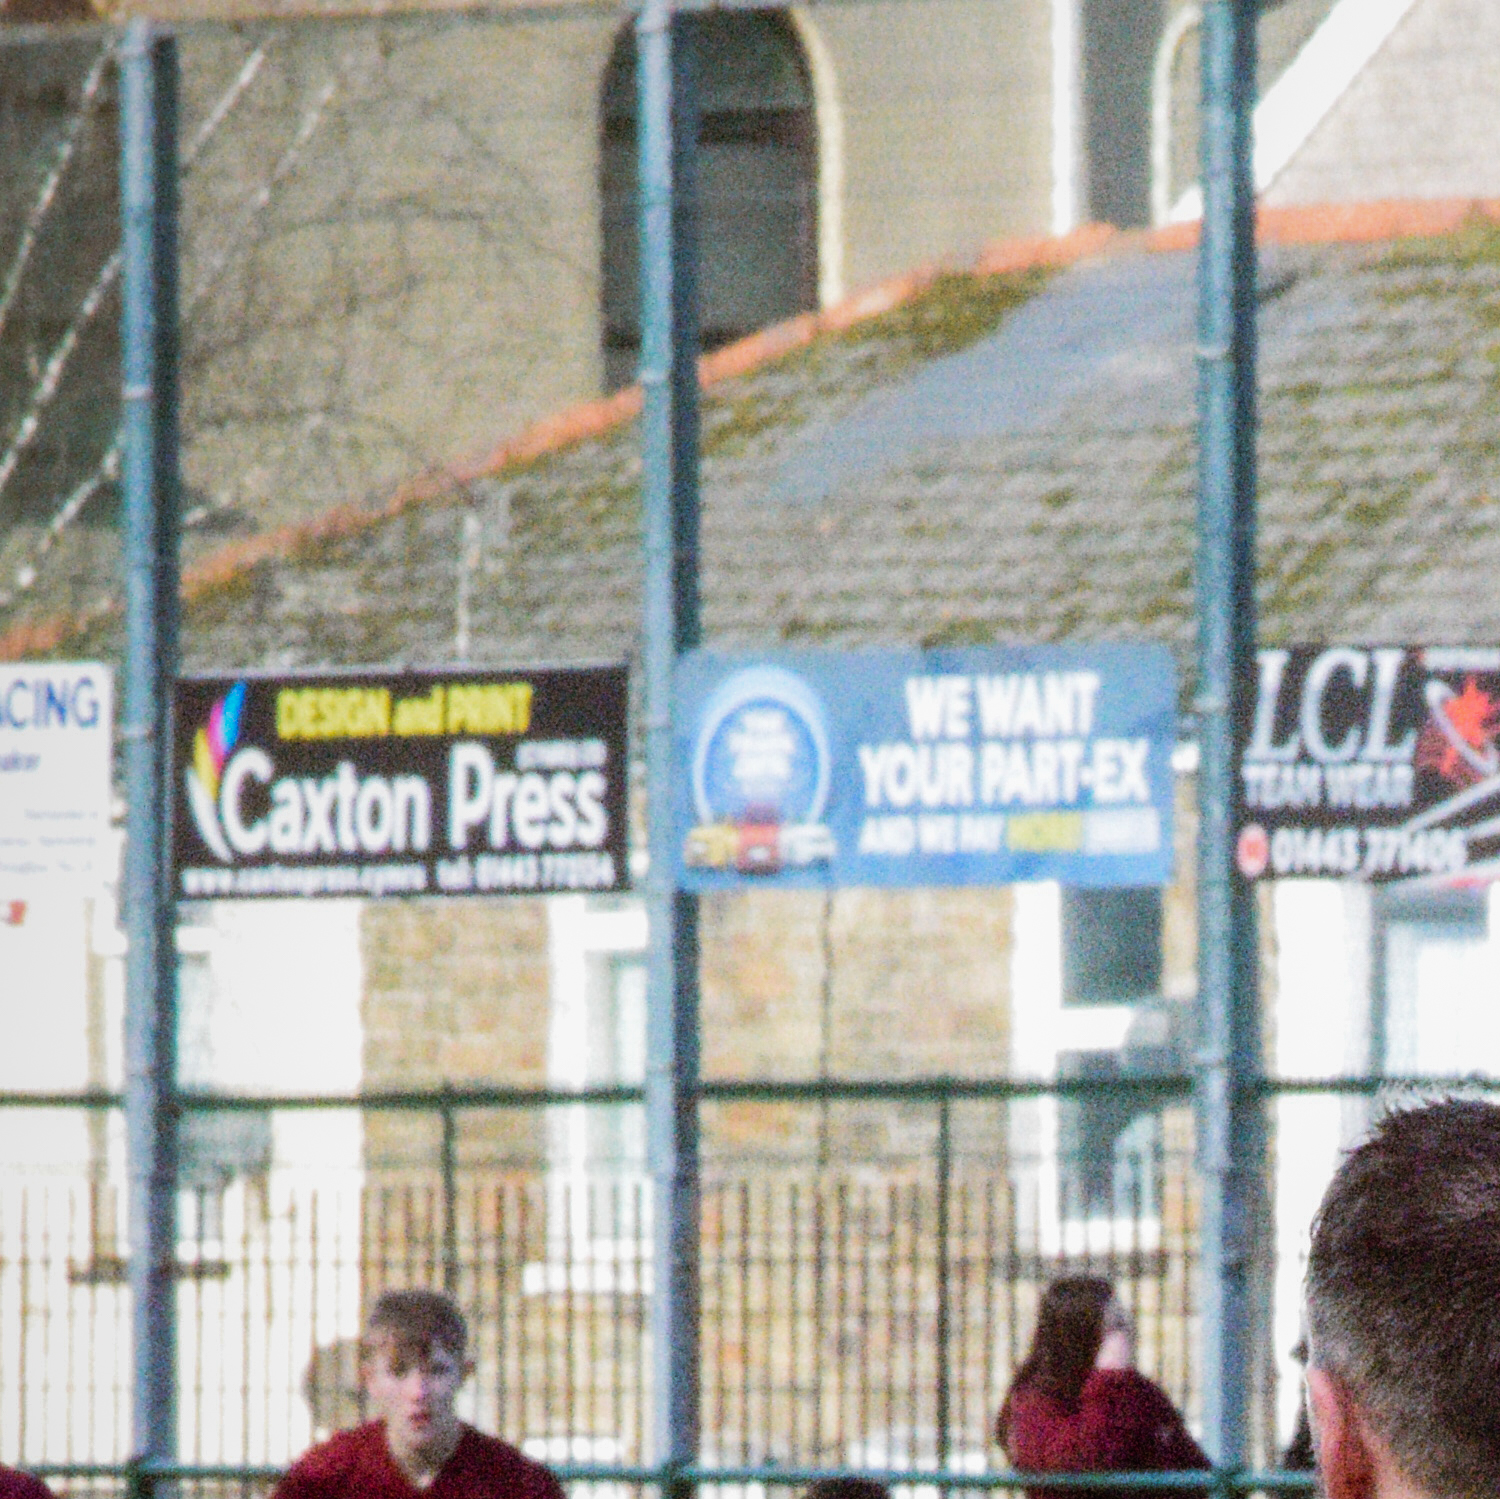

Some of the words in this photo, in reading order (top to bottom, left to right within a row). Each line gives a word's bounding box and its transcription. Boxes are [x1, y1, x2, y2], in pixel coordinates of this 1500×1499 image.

[0, 676, 99, 729] CING
[276, 687, 390, 739] DESIGN
[394, 683, 443, 736] and
[447, 682, 534, 735] PRINT
[906, 673, 970, 740] WE
[976, 670, 1098, 738] WANT
[1243, 648, 1417, 763] LCL
[221, 746, 430, 856] Caxton
[449, 741, 608, 849] Press
[858, 742, 975, 806] YOUR
[981, 738, 1150, 806] PART-EX
